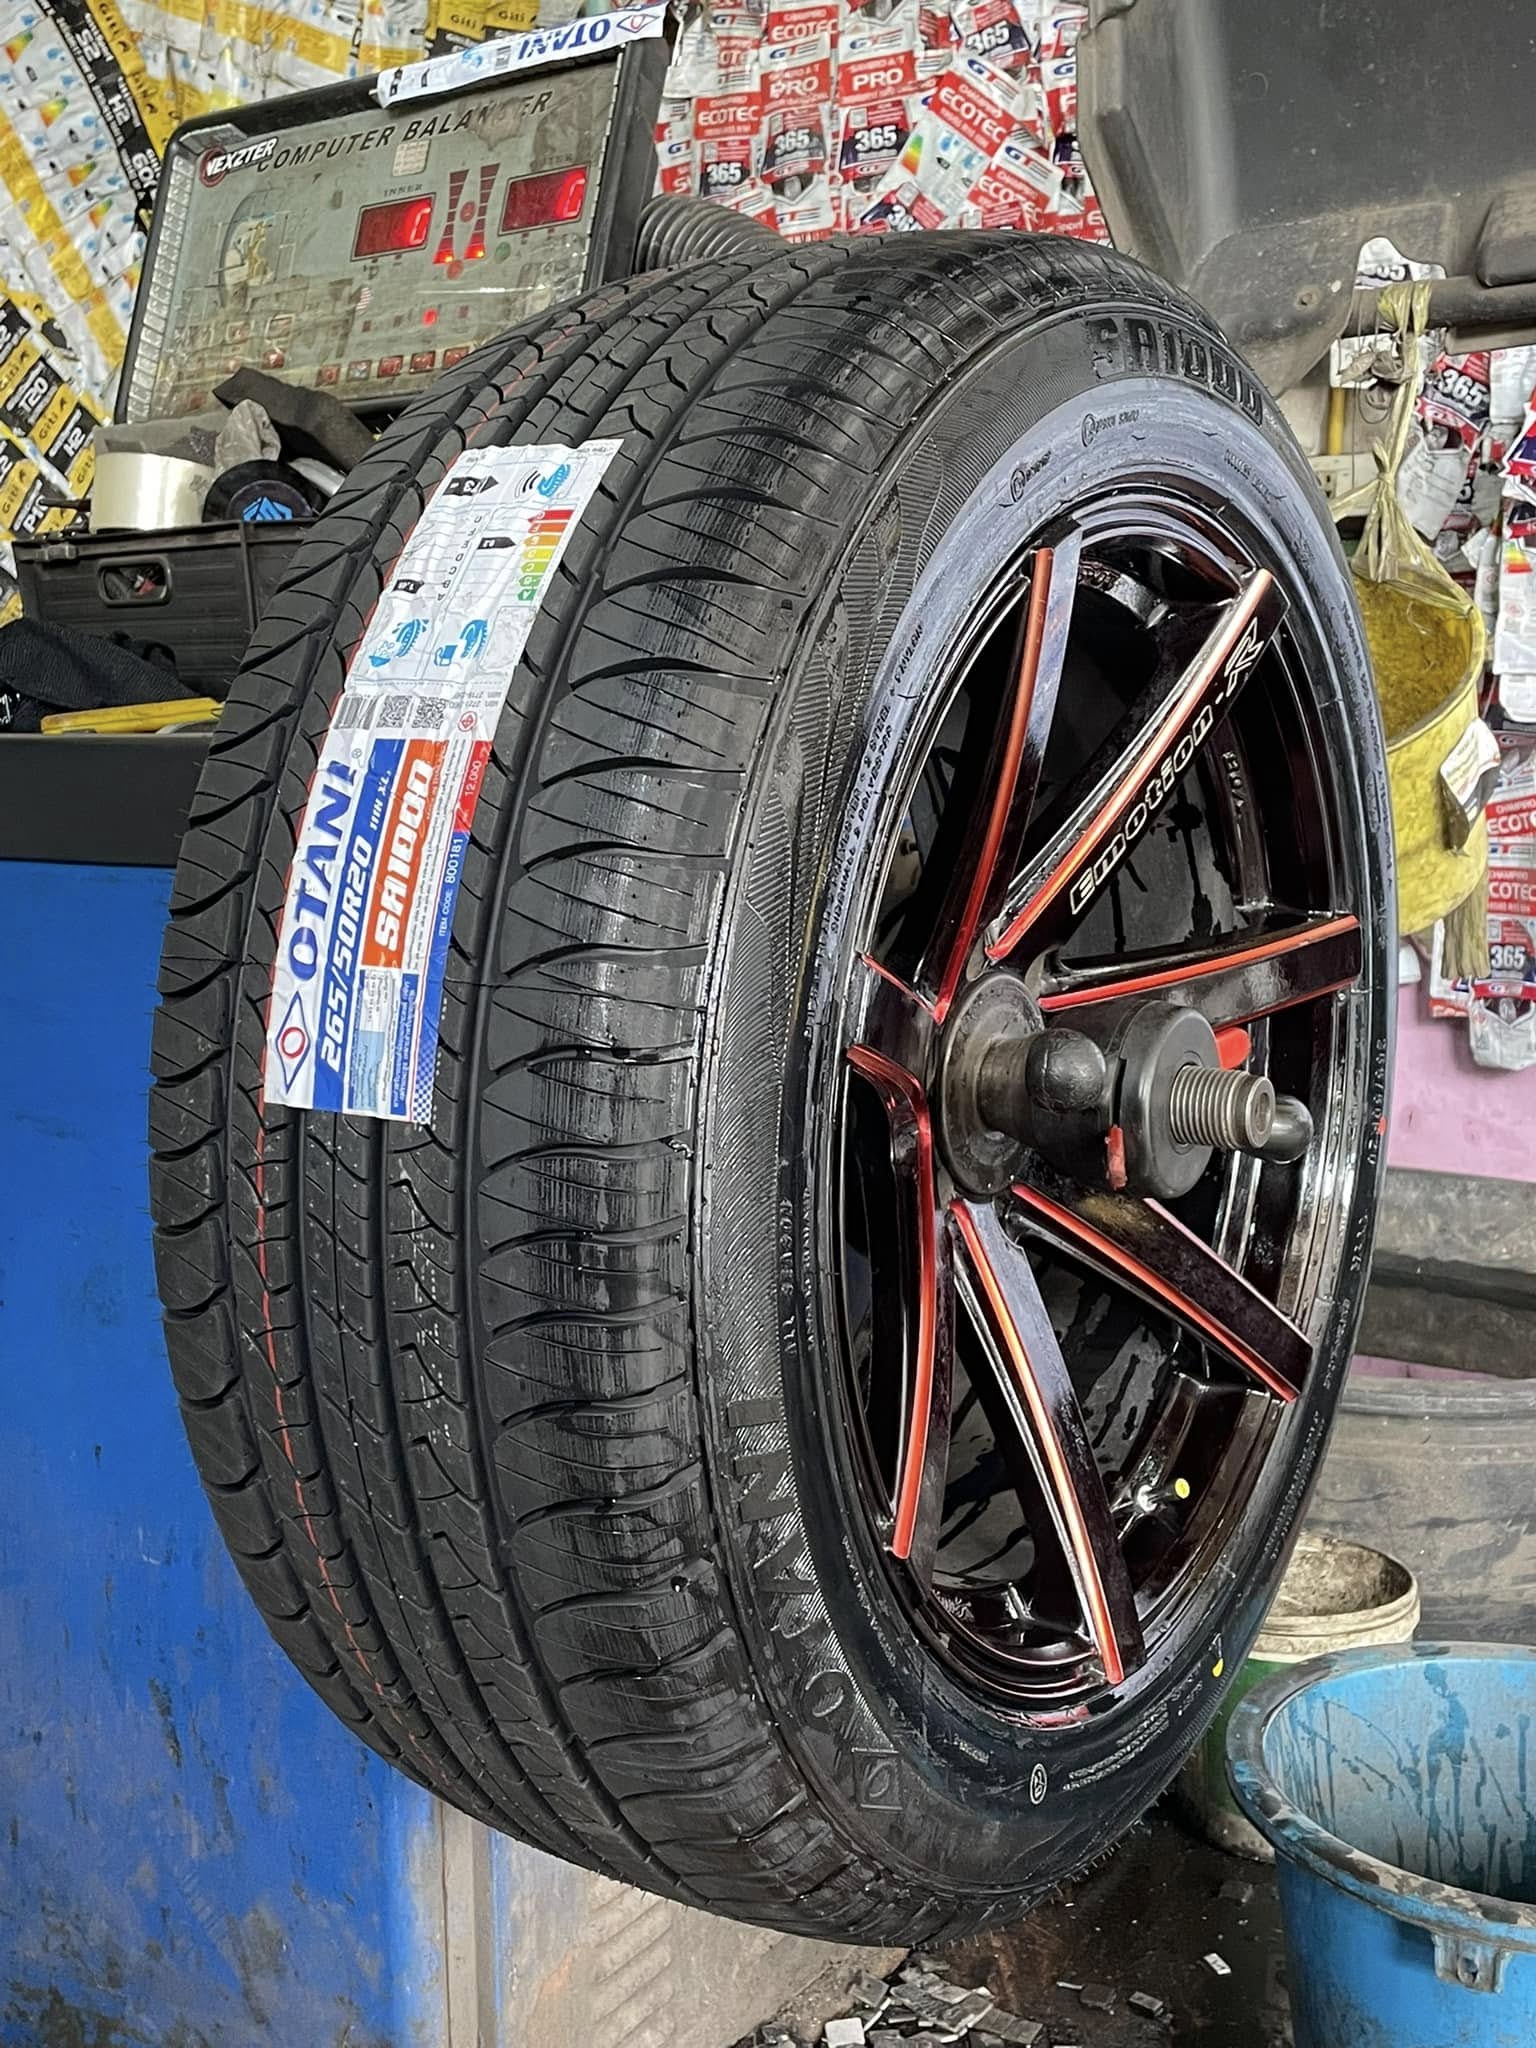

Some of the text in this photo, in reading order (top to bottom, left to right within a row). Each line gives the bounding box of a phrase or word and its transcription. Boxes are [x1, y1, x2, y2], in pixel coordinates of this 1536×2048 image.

[518, 18, 611, 60] OTANI
[771, 19, 839, 41] ECOTEC
[967, 21, 1010, 55] 365
[770, 76, 819, 98] PRO
[853, 68, 904, 91] PRO
[698, 105, 760, 126] ECOTEC
[939, 87, 1007, 142] ECOTEC
[775, 129, 811, 154] 365
[855, 125, 897, 152] 365
[706, 163, 742, 184] 365
[18, 376, 49, 413] T20
[1437, 368, 1489, 407] 365
[63, 426, 87, 458] H2
[289, 761, 357, 981] OTANI
[374, 759, 434, 952] SA1000
[444, 838, 463, 883] 800181
[321, 835, 372, 1073] 265/50R20
[1491, 945, 1526, 970] 365
